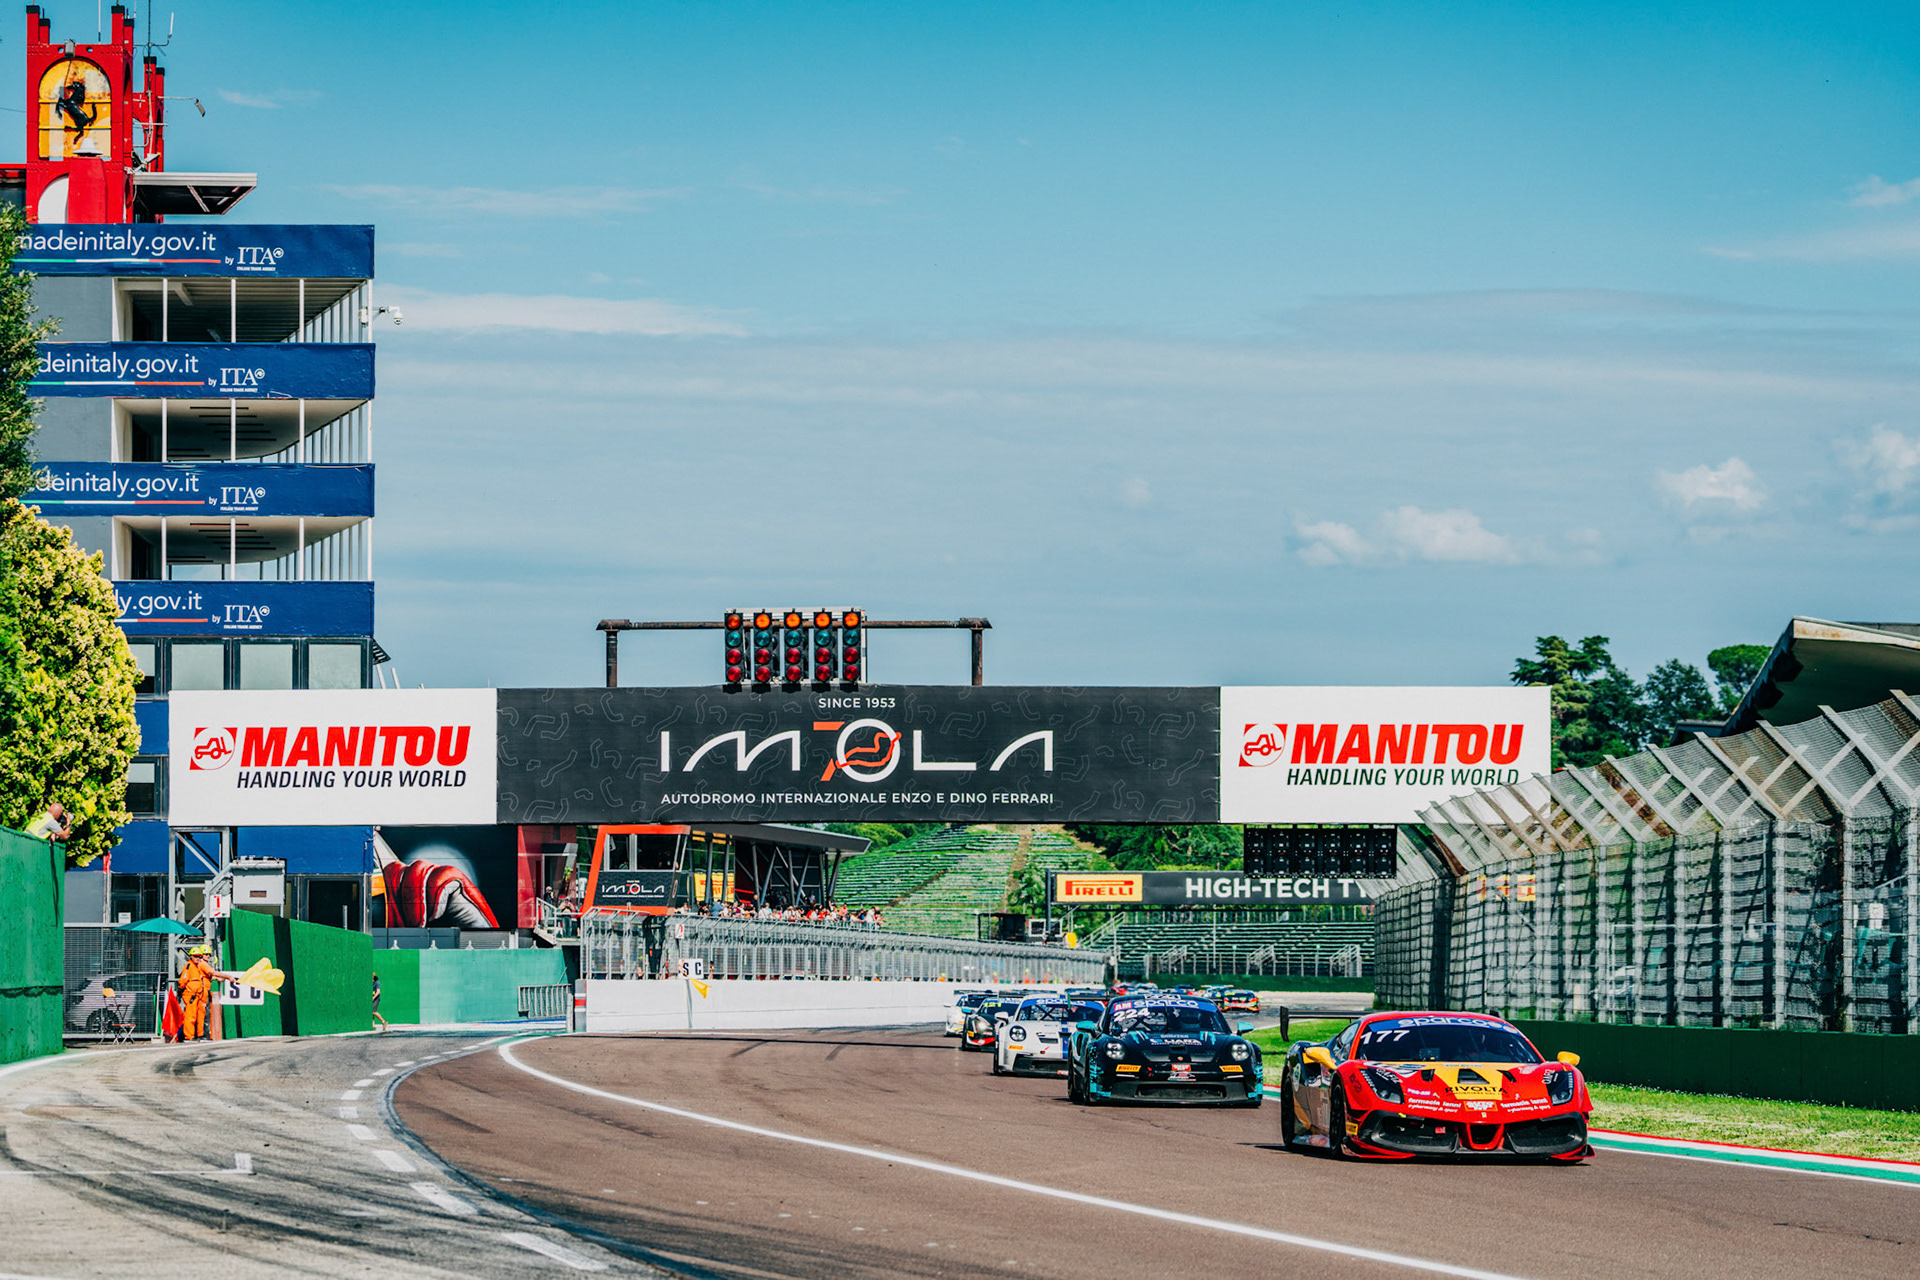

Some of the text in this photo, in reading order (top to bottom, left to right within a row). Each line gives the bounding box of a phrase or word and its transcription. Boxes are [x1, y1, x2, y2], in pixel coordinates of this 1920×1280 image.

[225, 247, 276, 266] by ITA
[38, 351, 199, 378] deinitaly.gov.it
[208, 368, 258, 387] by ITA
[36, 470, 199, 498] deinitaly.gov.it
[208, 486, 259, 506] by ITA
[212, 605, 263, 624] by ITA
[818, 697, 896, 709] SINCE 1953
[240, 726, 471, 768] MANITOU
[1290, 723, 1524, 765] MANITOU
[237, 769, 466, 789] HANDLING YOUR WORLD
[1286, 768, 1519, 786] HANDLING YOUR WORLD
[661, 793, 1054, 805] AUTODROMO INTERNAZIONALE ENZO E DINO FERRARI
[1065, 880, 1134, 896] PIRELLI
[1185, 878, 1330, 898] HIGH-TECH
[1113, 1008, 1150, 1022] 224
[1114, 1002, 1131, 1010] AM
[1398, 1016, 1489, 1029] sparco
[1360, 1029, 1410, 1045] 177
